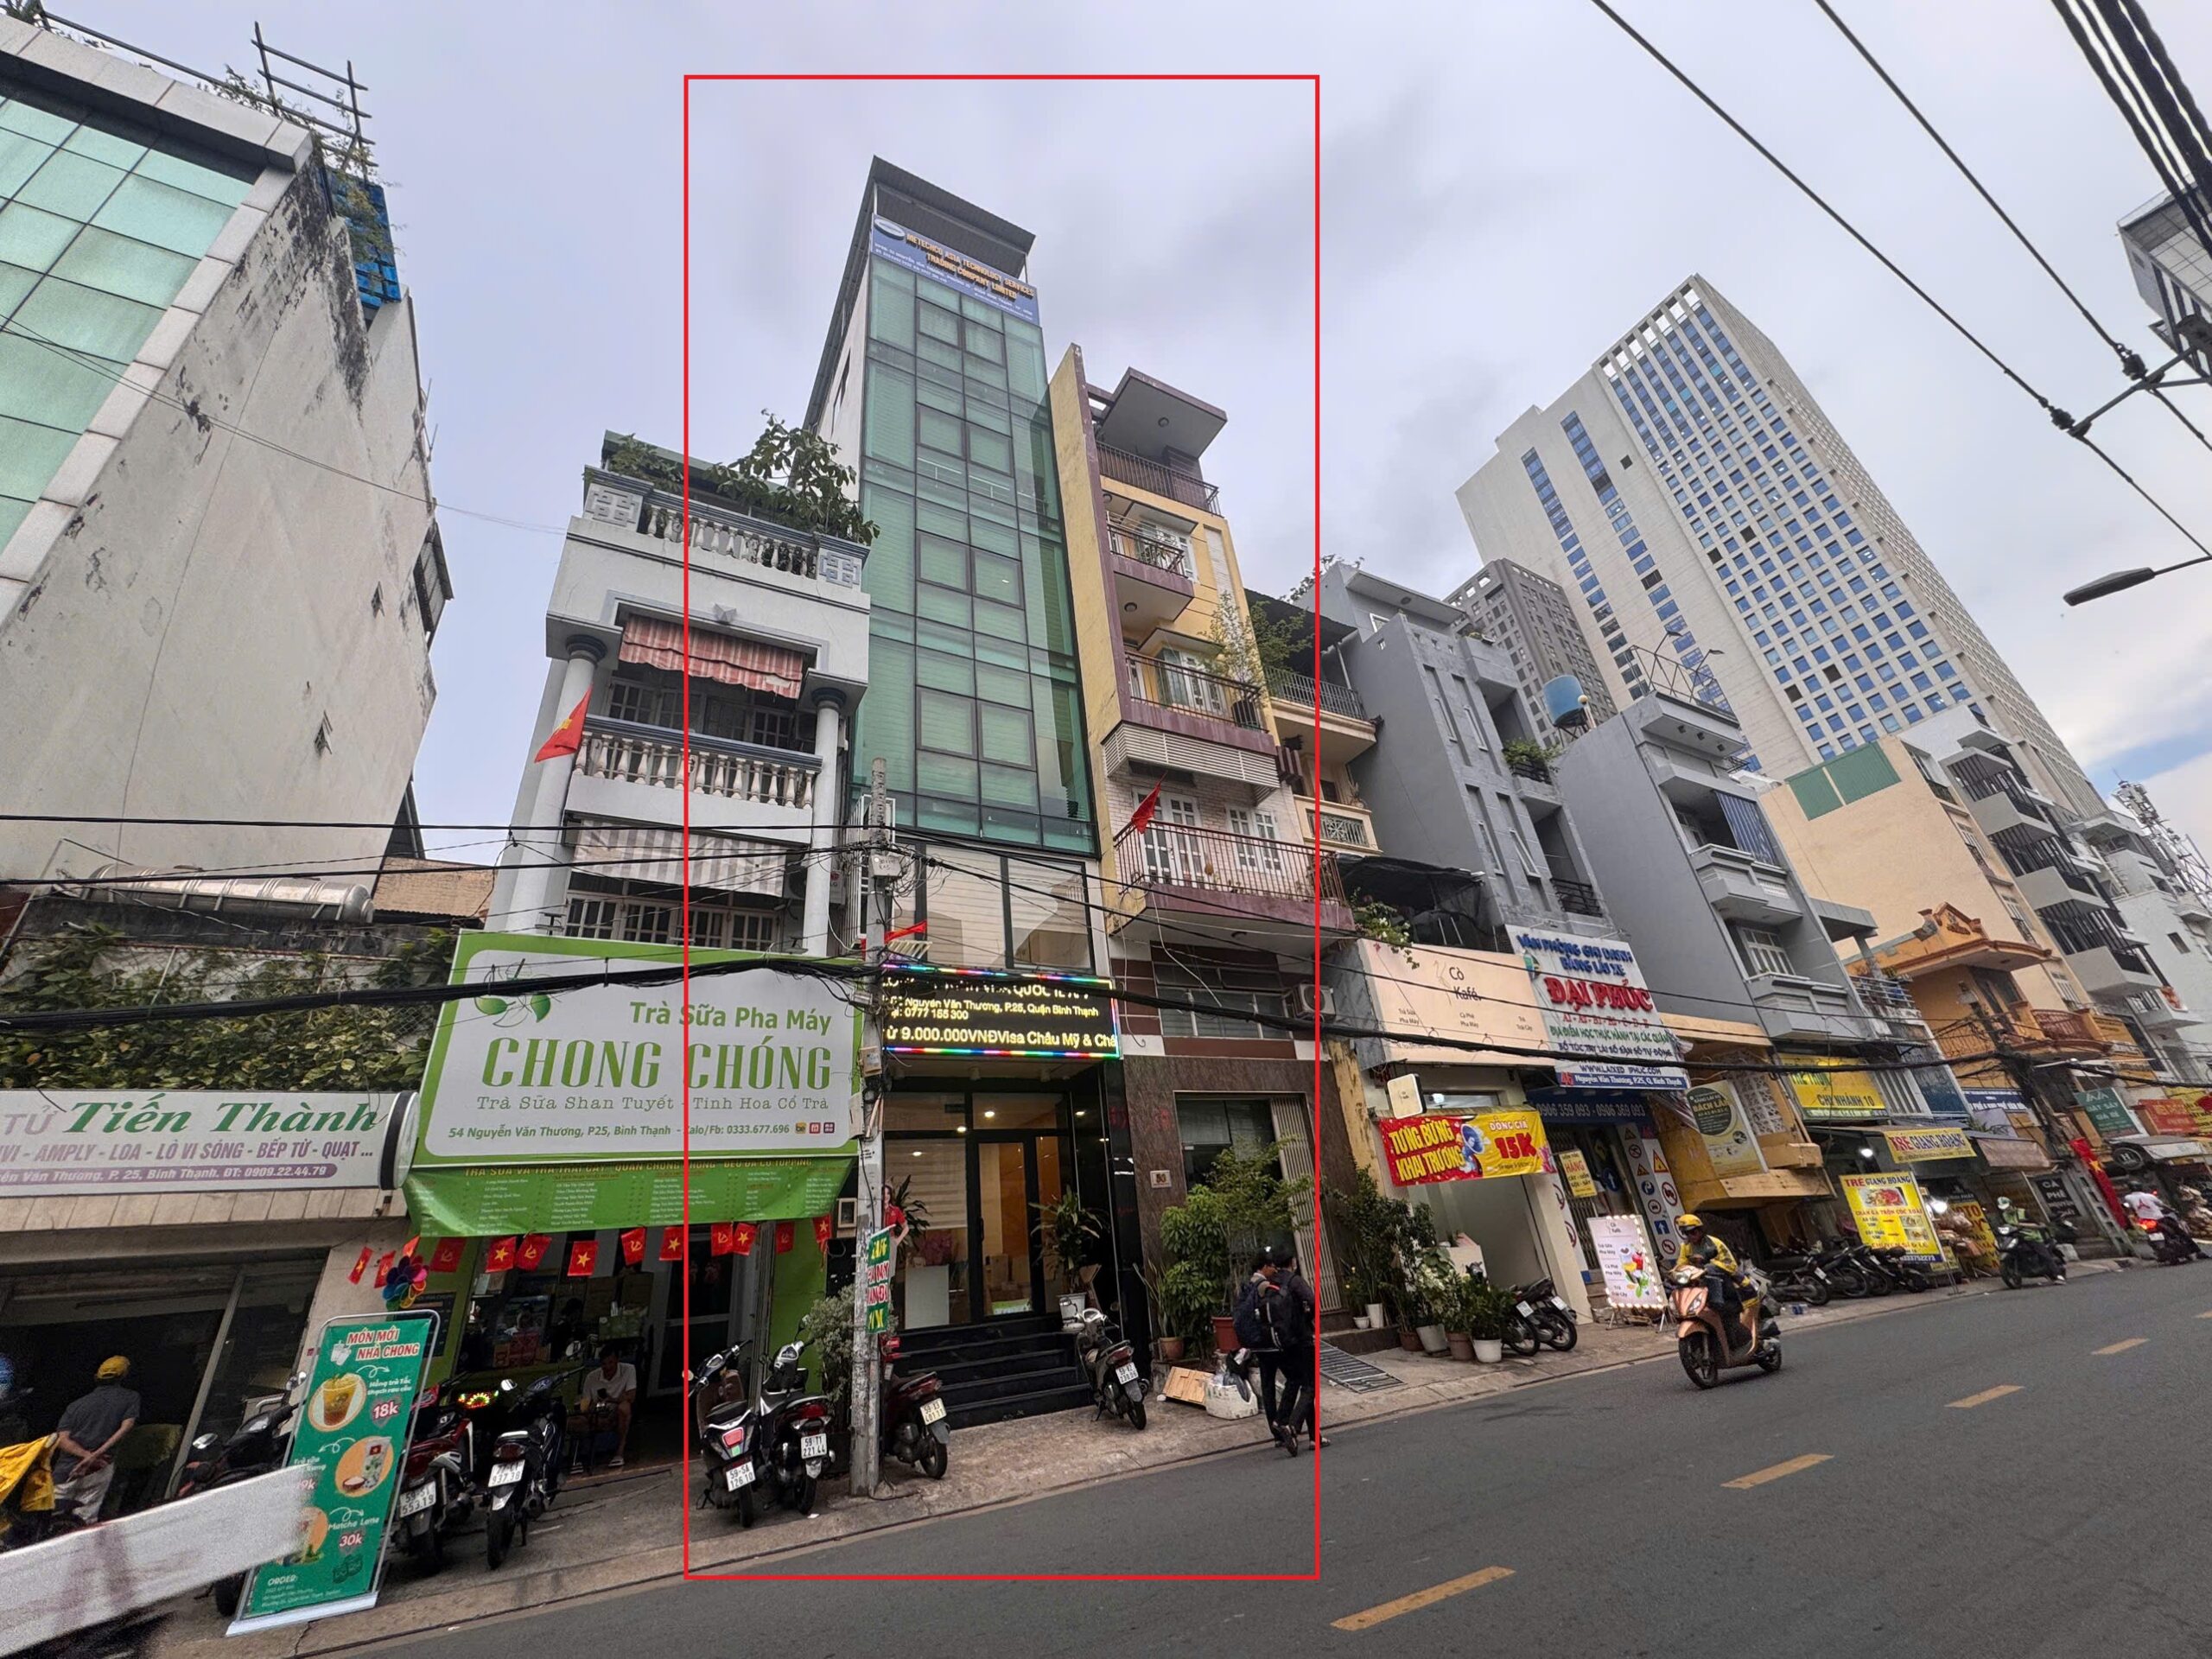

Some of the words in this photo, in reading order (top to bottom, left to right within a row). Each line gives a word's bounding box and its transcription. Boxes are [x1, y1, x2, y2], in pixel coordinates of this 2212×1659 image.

[926, 252, 957, 272] TRADING
[991, 282, 1017, 301] LIMITED
[1448, 966, 1465, 981] Cò
[629, 1000, 671, 1025] Trà
[679, 1002, 727, 1027] Sữa
[734, 1007, 779, 1029] Pha
[785, 1007, 832, 1037] Máy
[904, 1007, 931, 1019] 0777
[950, 1008, 969, 1020] 300
[1027, 1029, 1060, 1046] Châu
[1061, 1032, 1080, 1050] Mỹ
[481, 1037, 662, 1089] CHONG
[685, 1035, 832, 1090] CHÓNG
[477, 1096, 511, 1110] Trà
[564, 1096, 614, 1110] Shan
[621, 1094, 674, 1112] Tuyết
[693, 1096, 734, 1110] Tinh
[739, 1096, 772, 1110] Hoa
[802, 1096, 829, 1110] Trà
[3, 1104, 59, 1135] TỬ
[62, 1092, 193, 1134] Tiến
[209, 1102, 376, 1133] Thành
[448, 1127, 464, 1138] 54
[467, 1124, 512, 1141] Nguyễn
[515, 1126, 536, 1137] Văn
[539, 1126, 584, 1139] Thương,
[588, 1126, 611, 1138] P25,
[613, 1125, 638, 1136] Bình
[640, 1125, 671, 1138] Thạnh
[685, 1124, 725, 1135] alo/Fb:
[726, 1124, 791, 1135] 0333.677.696
[35, 1144, 98, 1162] AMPLY
[109, 1143, 143, 1161] LOA
[156, 1139, 179, 1160] LÒ
[181, 1142, 200, 1160] VI
[200, 1139, 245, 1160] SÓNG
[257, 1136, 288, 1159] BẾP
[321, 1141, 360, 1161] QUẠT
[1494, 1132, 1538, 1160] 15K
[123, 1168, 143, 1181] 25,
[223, 1166, 242, 1178] ĐT:
[245, 1166, 327, 1178] 0909.22.44.79
[1395, 1154, 1428, 1182] KHAI
[355, 1343, 382, 1361] NHÀ
[381, 1342, 421, 1358] CHONG
[372, 1401, 399, 1419] 18k
[339, 1533, 363, 1548] 30k
